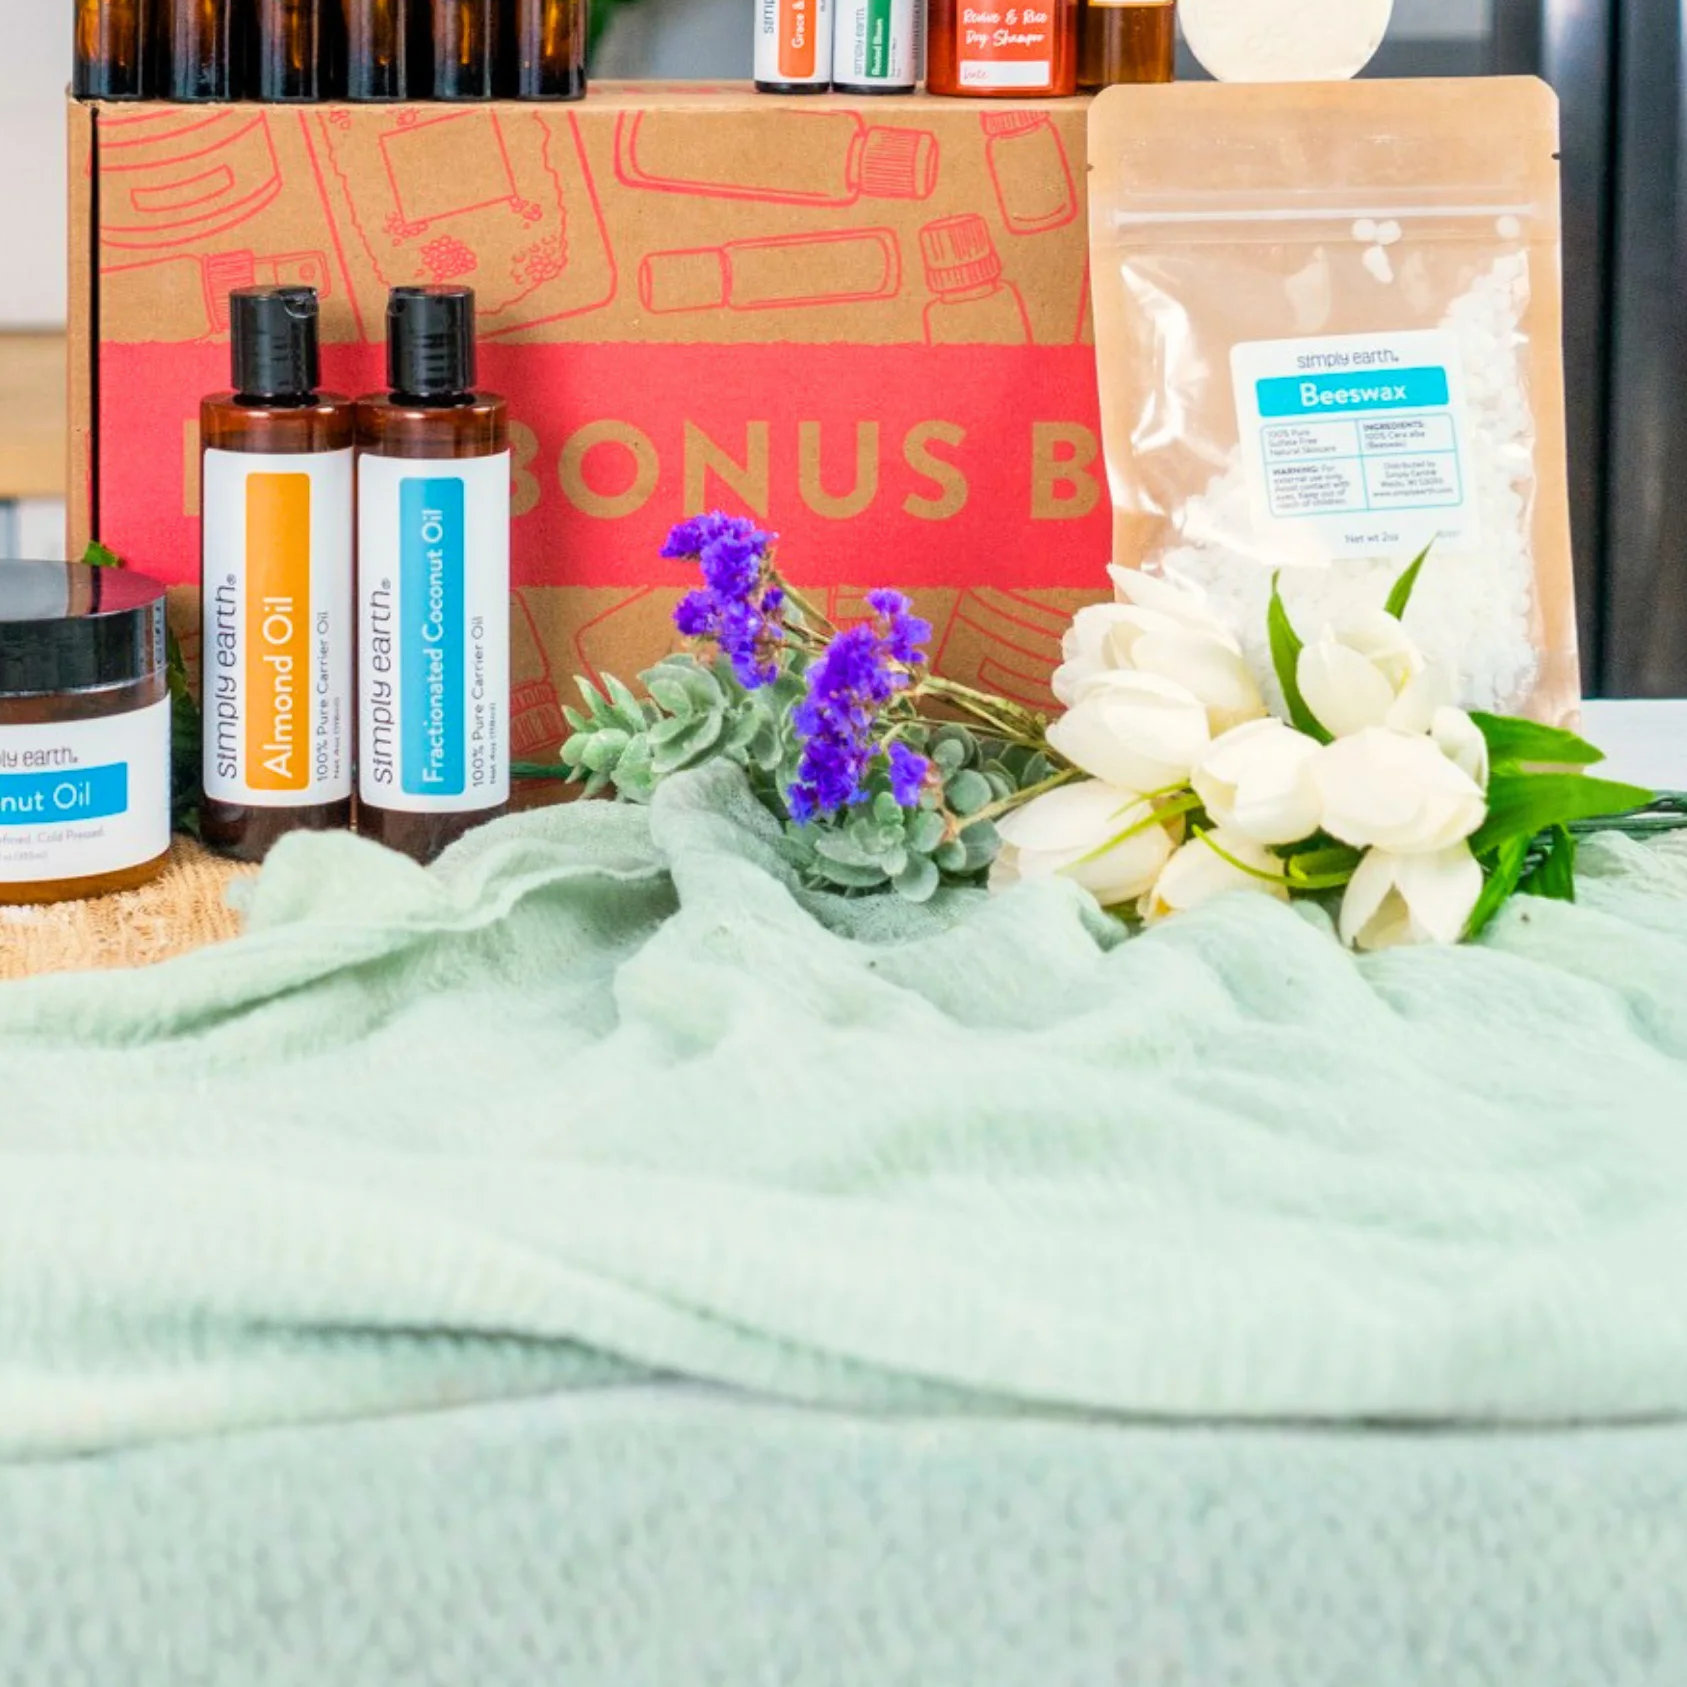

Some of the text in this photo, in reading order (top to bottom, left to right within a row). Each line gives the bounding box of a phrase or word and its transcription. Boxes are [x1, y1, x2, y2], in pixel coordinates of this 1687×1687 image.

[793, 0, 805, 10] &
[1004, 8, 1019, 25] &
[792, 14, 805, 48] Grace
[965, 29, 988, 49] Dry
[1296, 351, 1350, 369] simply
[1298, 381, 1409, 408] Beeswax
[421, 509, 445, 783] Fractionated Coconut Oil
[261, 596, 294, 779] Almond Oil
[315, 611, 329, 782] 100% Pure Carrier Oil
[470, 616, 485, 787] 100% Pure Carrier Oil
[214, 674, 240, 779] simply
[370, 680, 395, 785] simply
[52, 781, 91, 810] Oil
